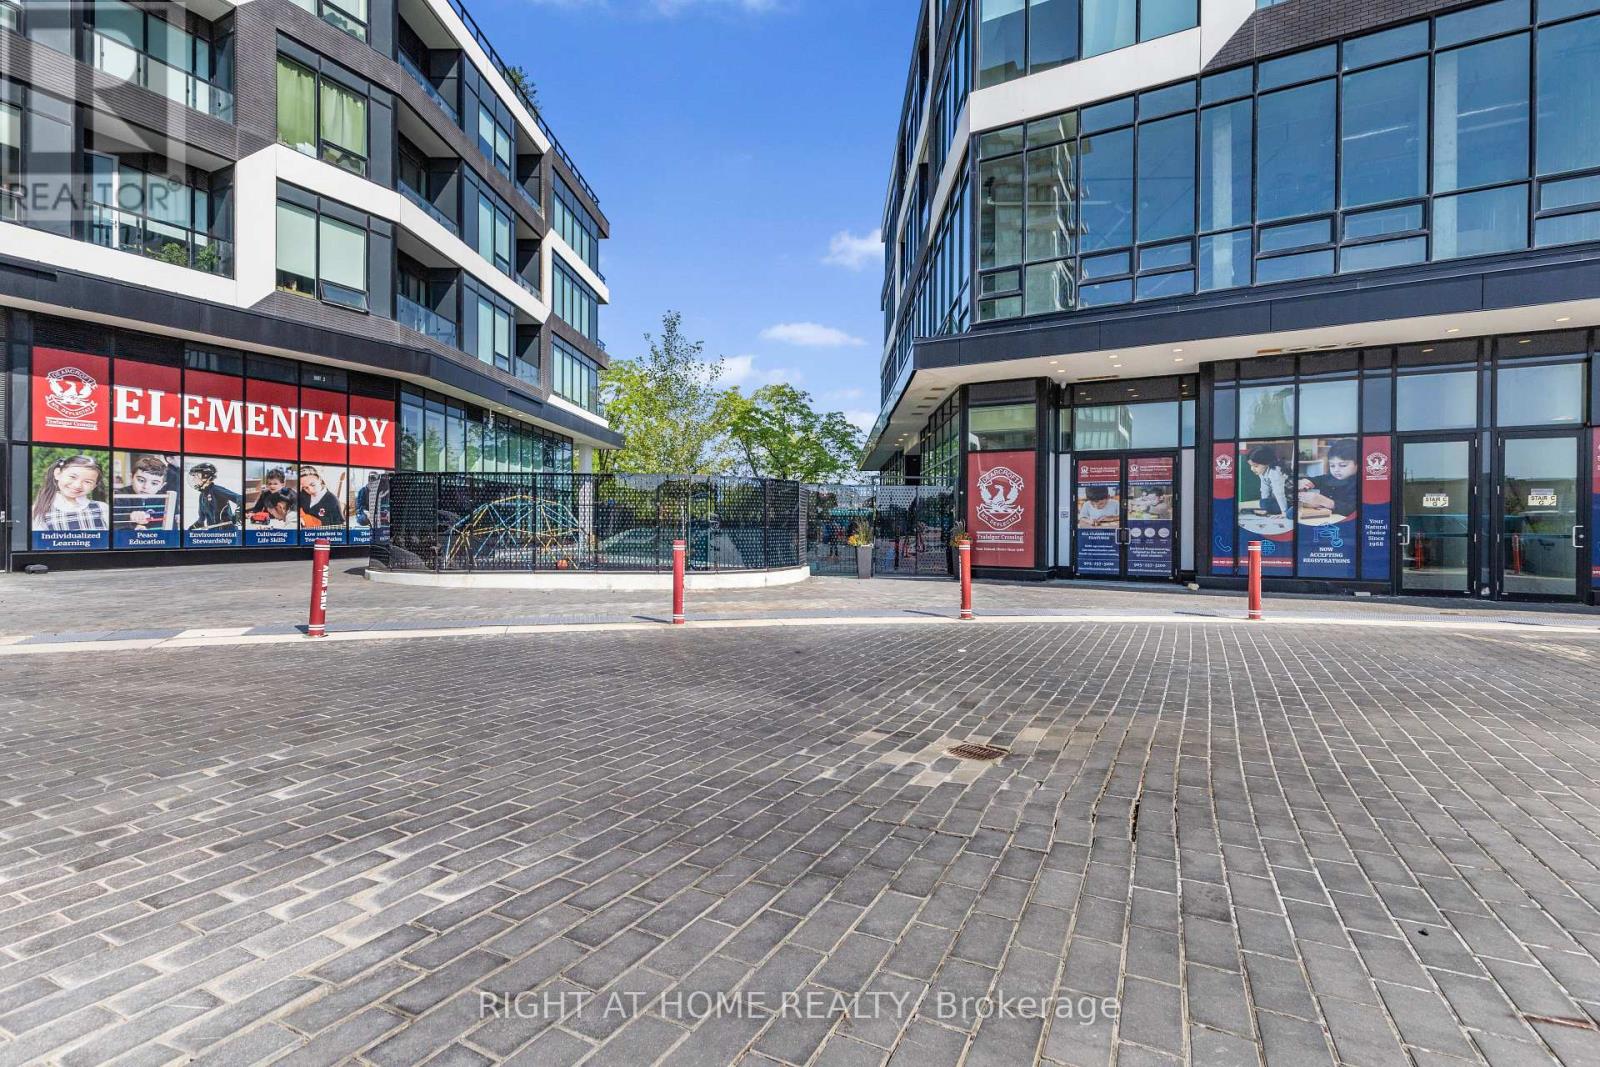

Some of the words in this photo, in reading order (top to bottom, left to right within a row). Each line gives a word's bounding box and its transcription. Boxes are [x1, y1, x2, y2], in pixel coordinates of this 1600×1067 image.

[113, 385, 389, 448] ELEMENTARY
[41, 532, 101, 540] Individualized
[976, 533, 1000, 541] Trafalgar
